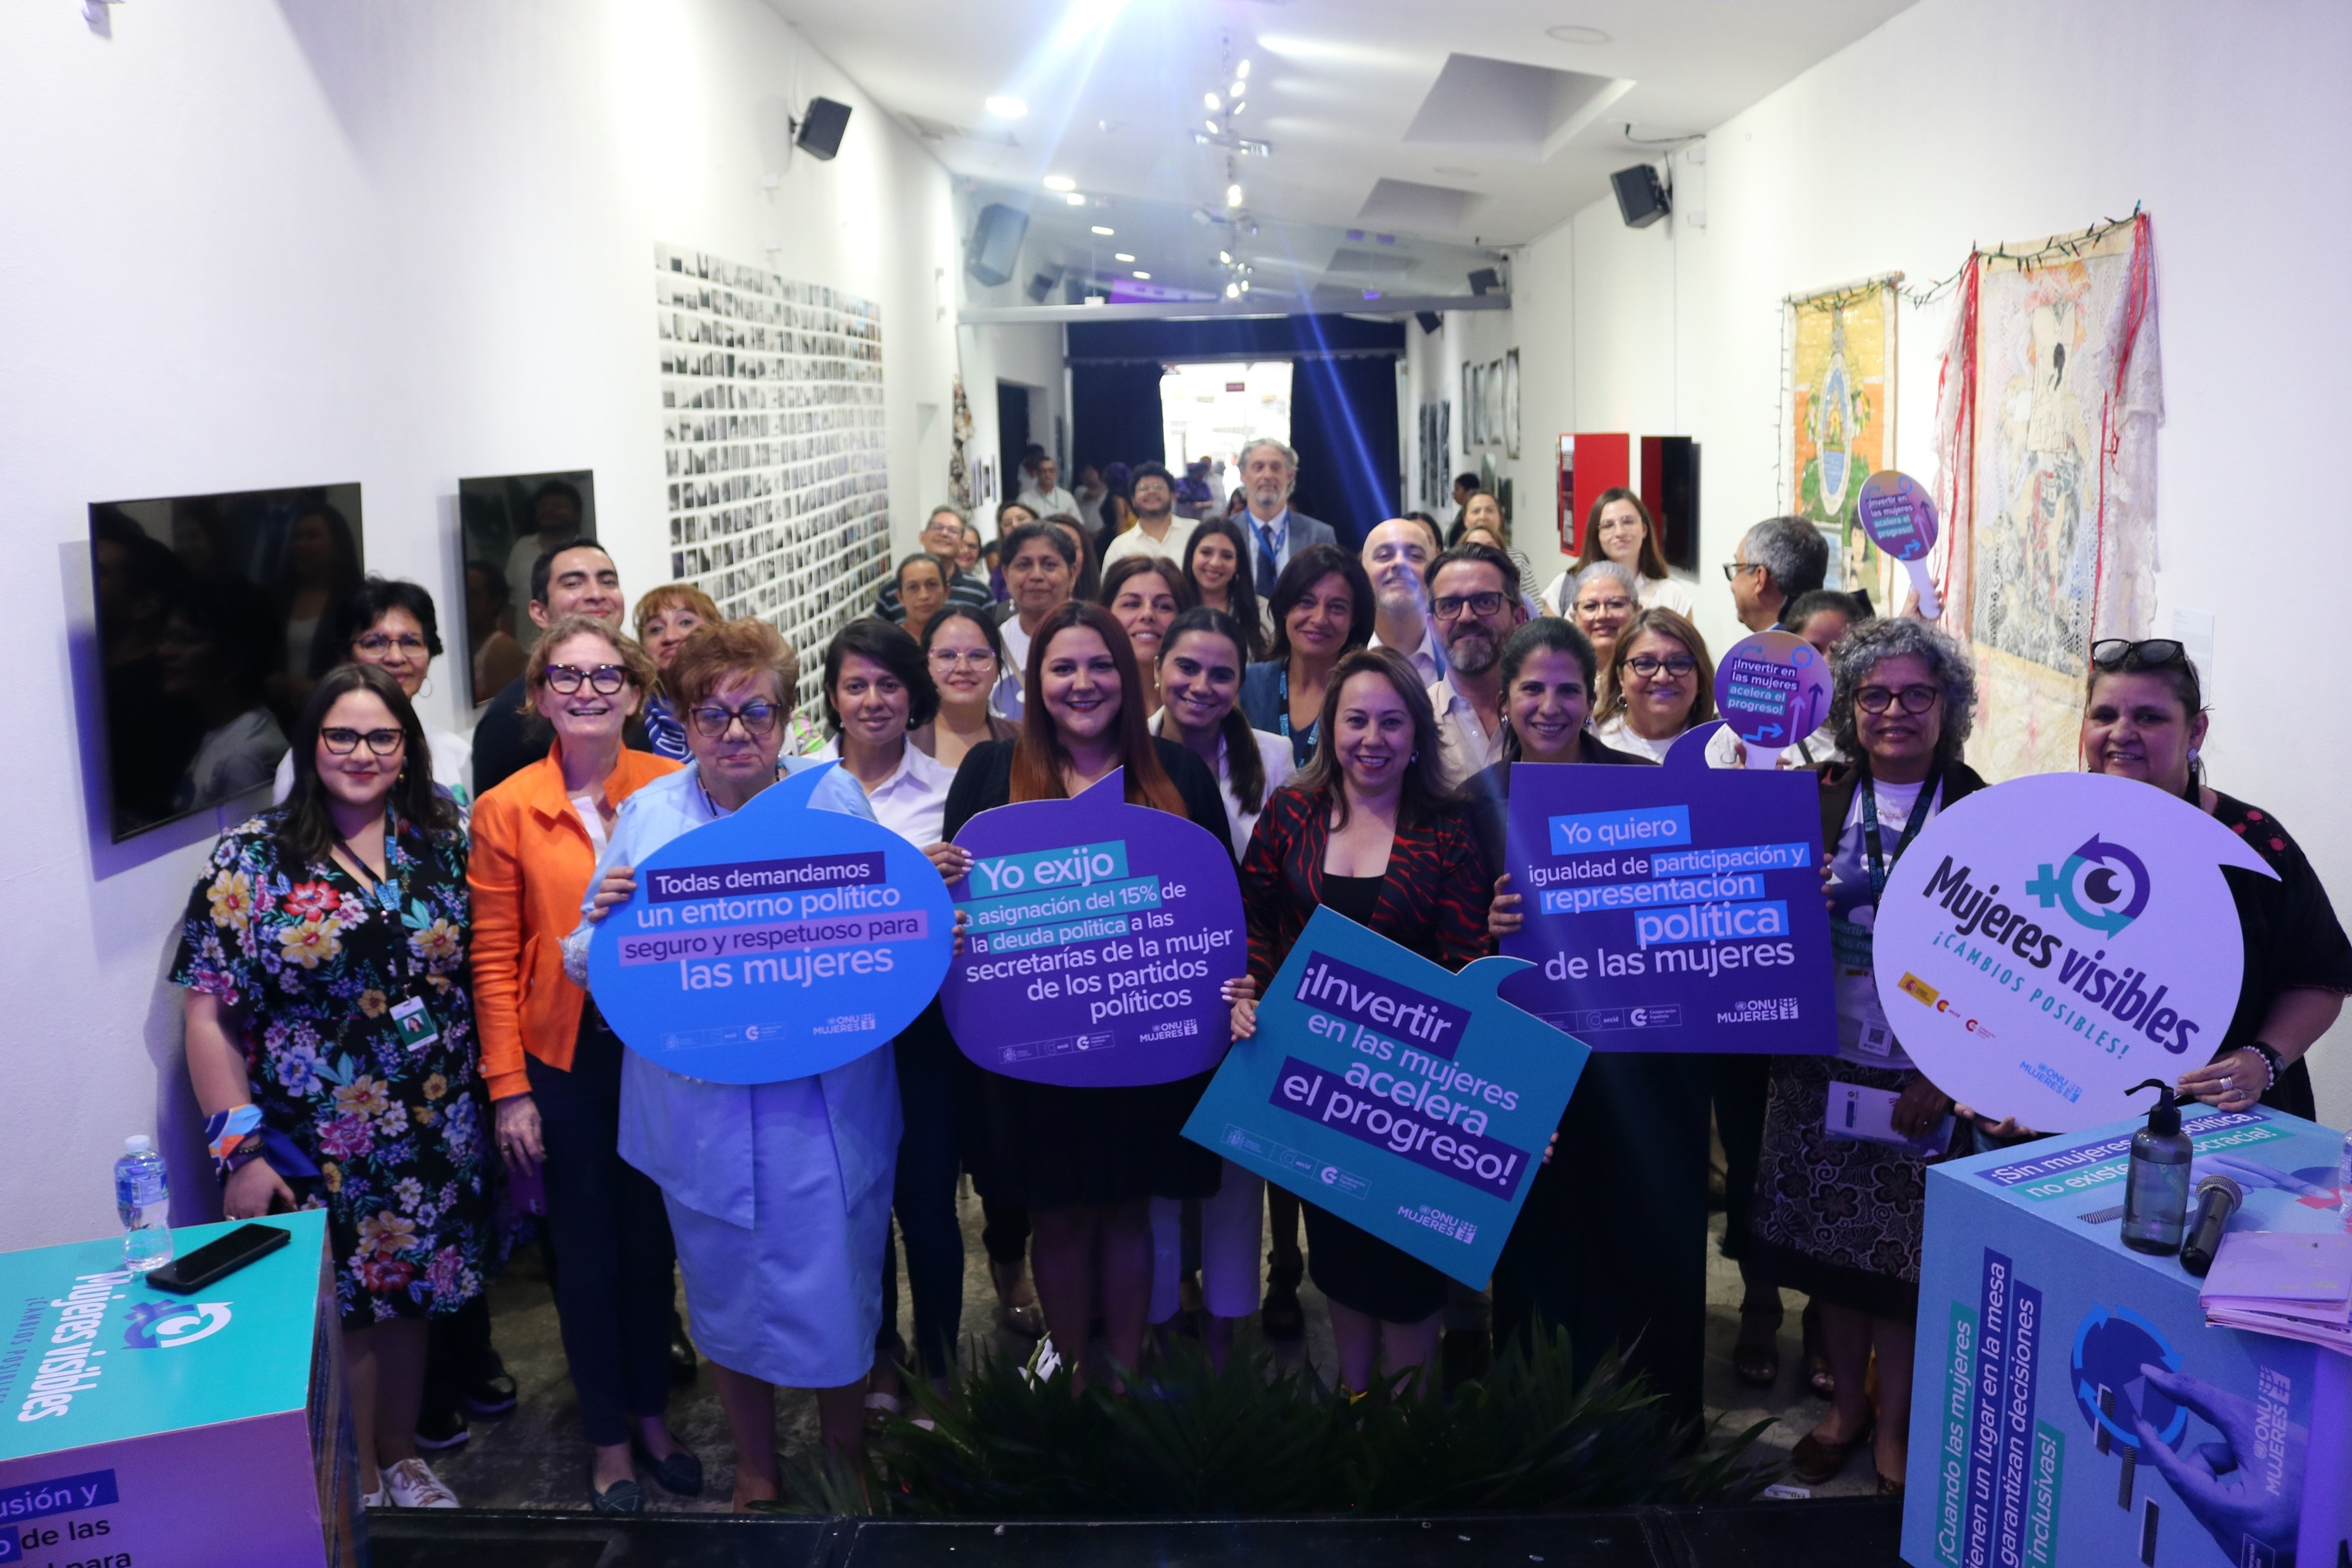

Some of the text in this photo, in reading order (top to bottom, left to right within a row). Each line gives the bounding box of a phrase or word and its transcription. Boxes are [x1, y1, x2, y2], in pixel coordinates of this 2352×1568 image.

[1870, 505, 1913, 517] las mujeres
[1874, 517, 1901, 528] acelera
[1877, 525, 1914, 539] progreso!
[1732, 671, 1798, 691] las mujeres
[1733, 659, 1796, 677] ¡Invertir en
[1727, 698, 1783, 715] progreso!
[1730, 685, 1785, 702] acelera el
[1560, 817, 1678, 846] Yo quiero
[656, 862, 870, 895] Todas demandamos
[978, 848, 1115, 891] Yo exijo
[1528, 846, 1805, 887] igualdad de participación y
[637, 884, 900, 928] un entorno político
[978, 896, 1081, 927] asignación
[1085, 890, 1115, 909] del
[1119, 884, 1158, 905] 15%
[1161, 883, 1187, 900] de
[1545, 871, 1756, 914] representación
[625, 915, 919, 961] seguro y respetuoso para
[971, 937, 988, 953] la
[992, 927, 1054, 951] deuda
[1131, 916, 1143, 931] a
[1147, 912, 1174, 928] las
[1637, 901, 1780, 950] política
[680, 948, 894, 991] las mujeres
[966, 927, 1234, 983] secretarías de la mujer
[1544, 939, 1795, 981] de las mujeres
[1922, 855, 2199, 1055] Mujeres visibles
[1026, 960, 1208, 1002] de los partidos
[1933, 931, 2131, 1060] ¡CAMBIOS POSIBLES!
[836, 1016, 859, 1024] ONU
[1090, 988, 1192, 1024] políticos
[1296, 963, 1452, 1043] ¡Invertir
[1717, 1010, 1778, 1024] MUJERES
[1747, 999, 1777, 1010] ONU
[813, 1024, 860, 1035] MUJERES
[1140, 1029, 1184, 1043] MUJERES
[1161, 1021, 1182, 1031] ONU
[1308, 1014, 1520, 1112] en las mujeres
[2019, 1061, 2071, 1097] MUJERES
[2047, 1066, 2070, 1088] ONU
[1345, 1062, 1488, 1138] acelera
[1283, 1076, 1518, 1186] el progreso!
[1991, 1166, 2044, 1184] ¡Sin
[2041, 1139, 2131, 1170] mujeres
[2026, 1183, 2064, 1197] no
[1396, 1206, 1456, 1236] MUJERES
[1429, 1208, 1459, 1228] ONU
[1987, 1263, 2005, 1332] mesa
[18, 1270, 133, 1422] Mujeres visibles
[1981, 1336, 2000, 1360] la
[1983, 1363, 1998, 1396] en
[1974, 1398, 1998, 1463] lugar
[2001, 1298, 2034, 1568] garantizan decisiones
[2254, 1396, 2272, 1441] ONU
[1939, 1320, 1971, 1565] ¡Cuando las mujeres
[2265, 1406, 2287, 1496] MUJERES
[80, 1484, 98, 1506] y
[1976, 1467, 1991, 1500] un
[2028, 1431, 2056, 1564] inclusivas!
[22, 1528, 59, 1550] de
[69, 1520, 111, 1541] las
